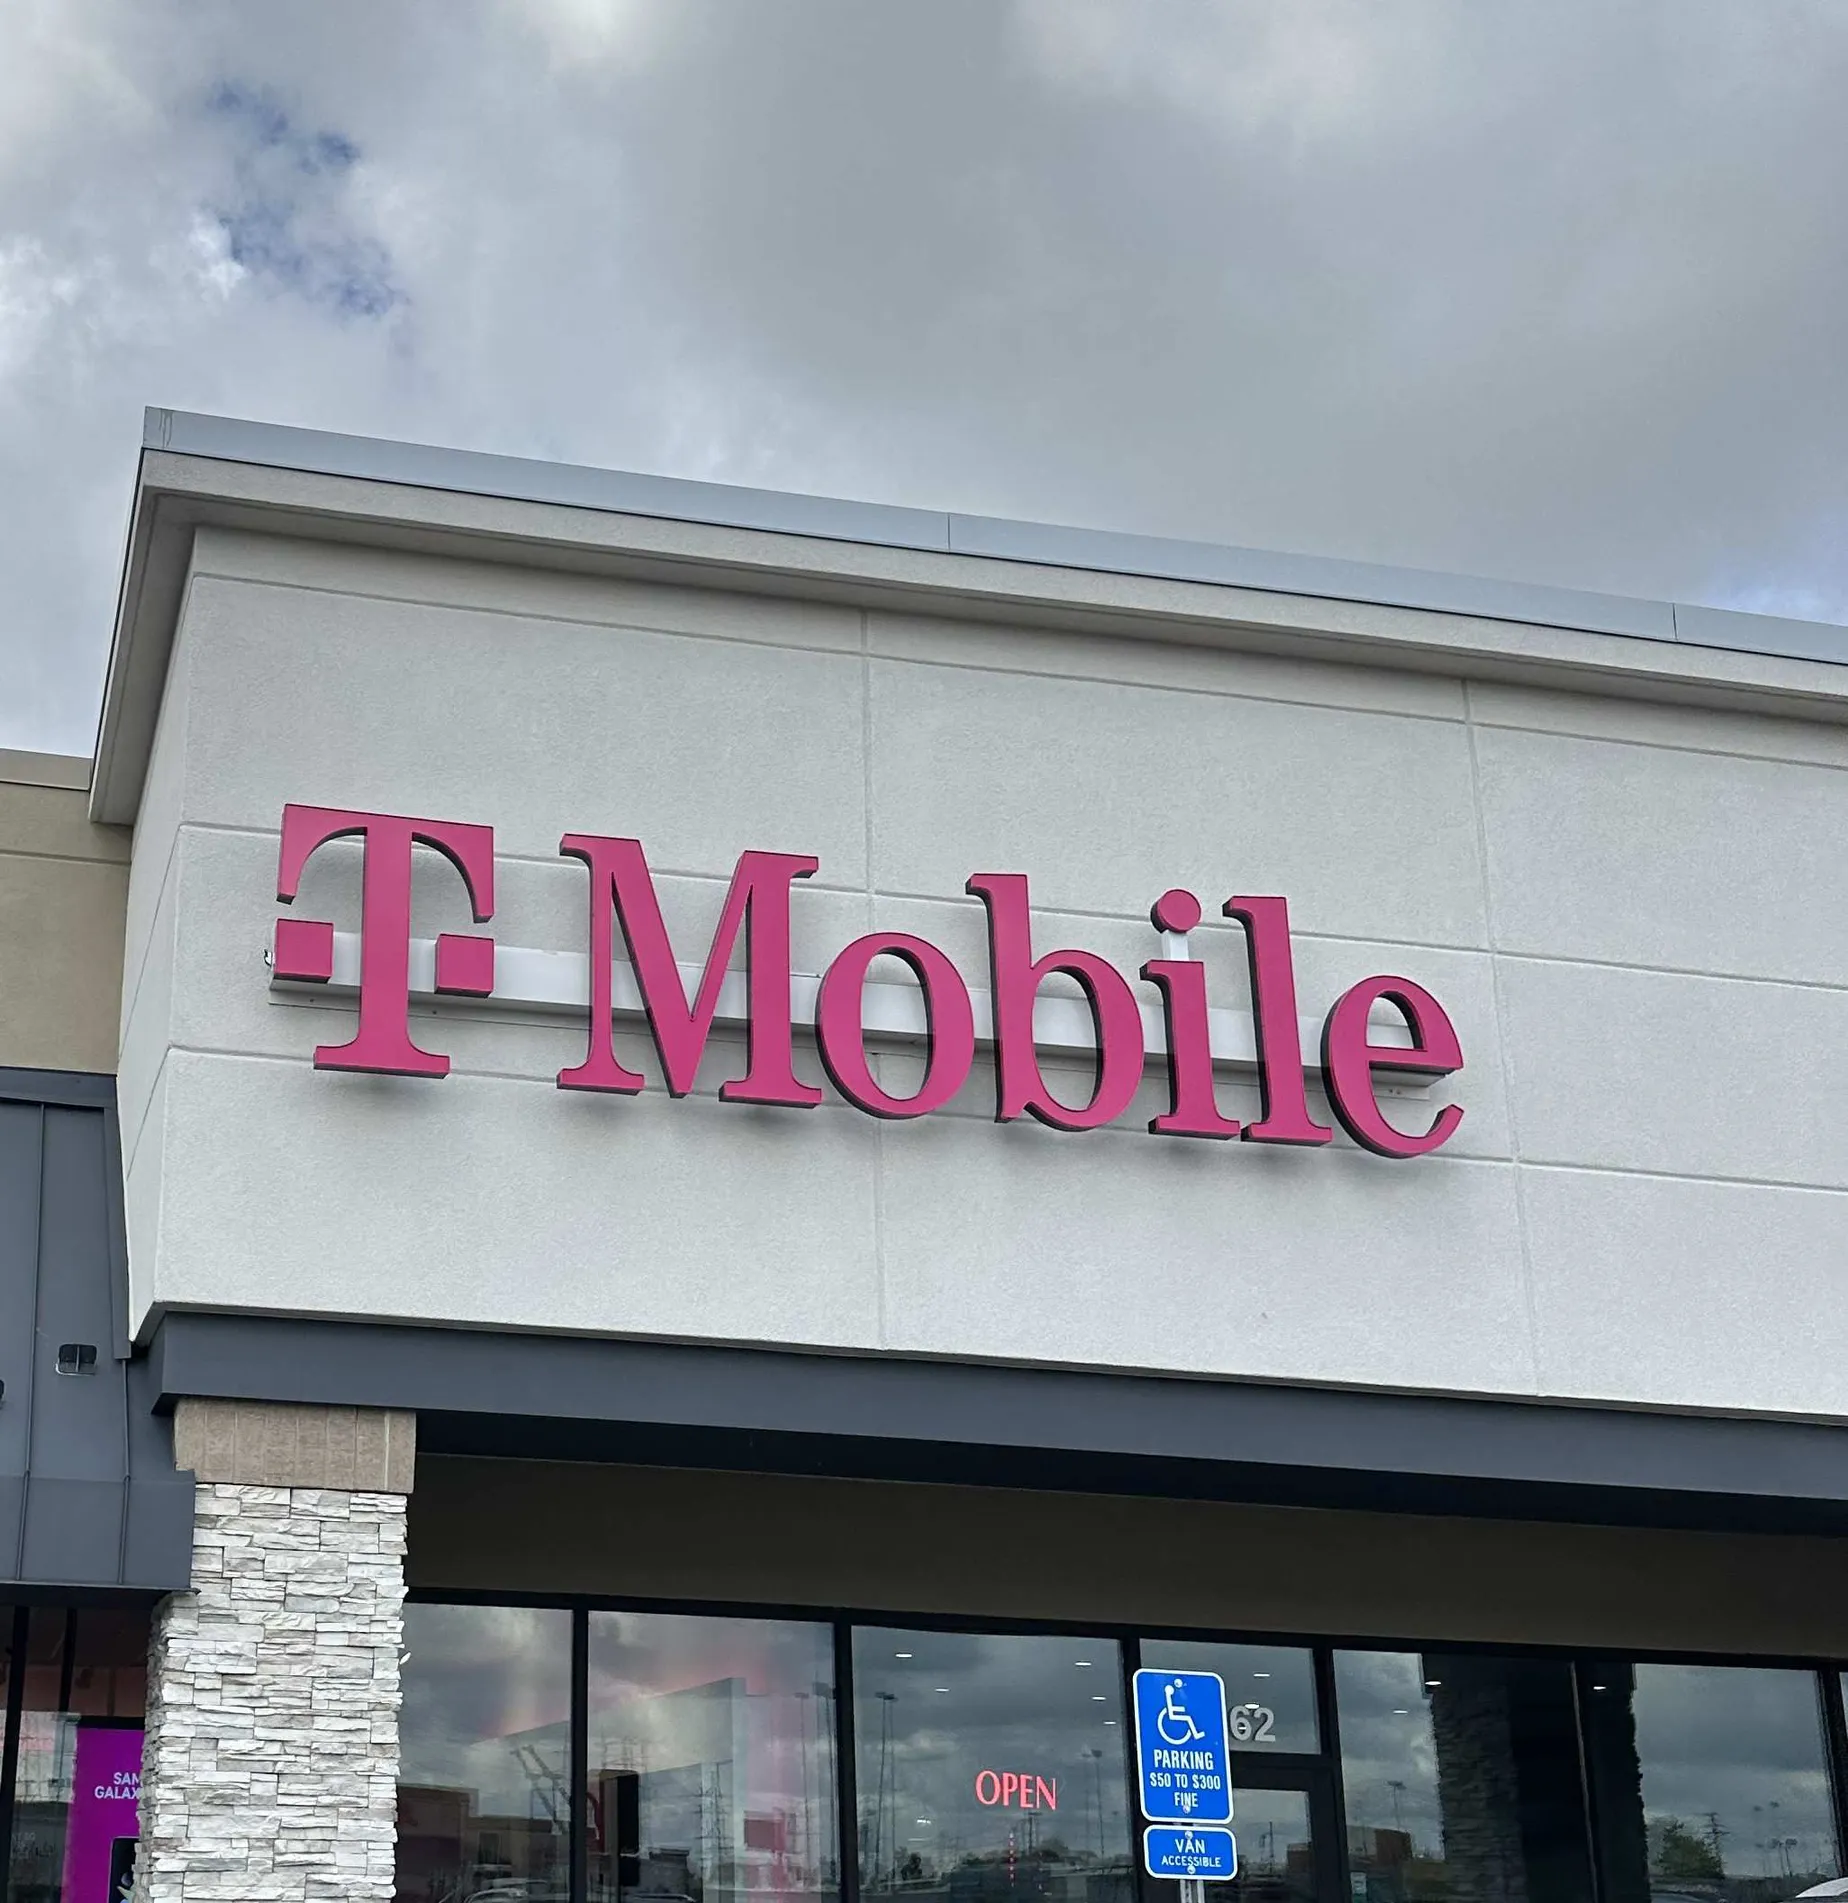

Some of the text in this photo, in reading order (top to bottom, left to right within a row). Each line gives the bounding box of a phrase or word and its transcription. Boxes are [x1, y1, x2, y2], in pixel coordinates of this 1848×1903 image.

[1229, 1705, 1276, 1743] 62
[1153, 1749, 1214, 1771] PARKING
[975, 1769, 1057, 1811] OPEN
[1149, 1772, 1221, 1790] $50 TO $300
[1174, 1791, 1199, 1808] FINE
[1174, 1838, 1206, 1854] VAN
[1161, 1854, 1223, 1868] ACCESSIBLE
